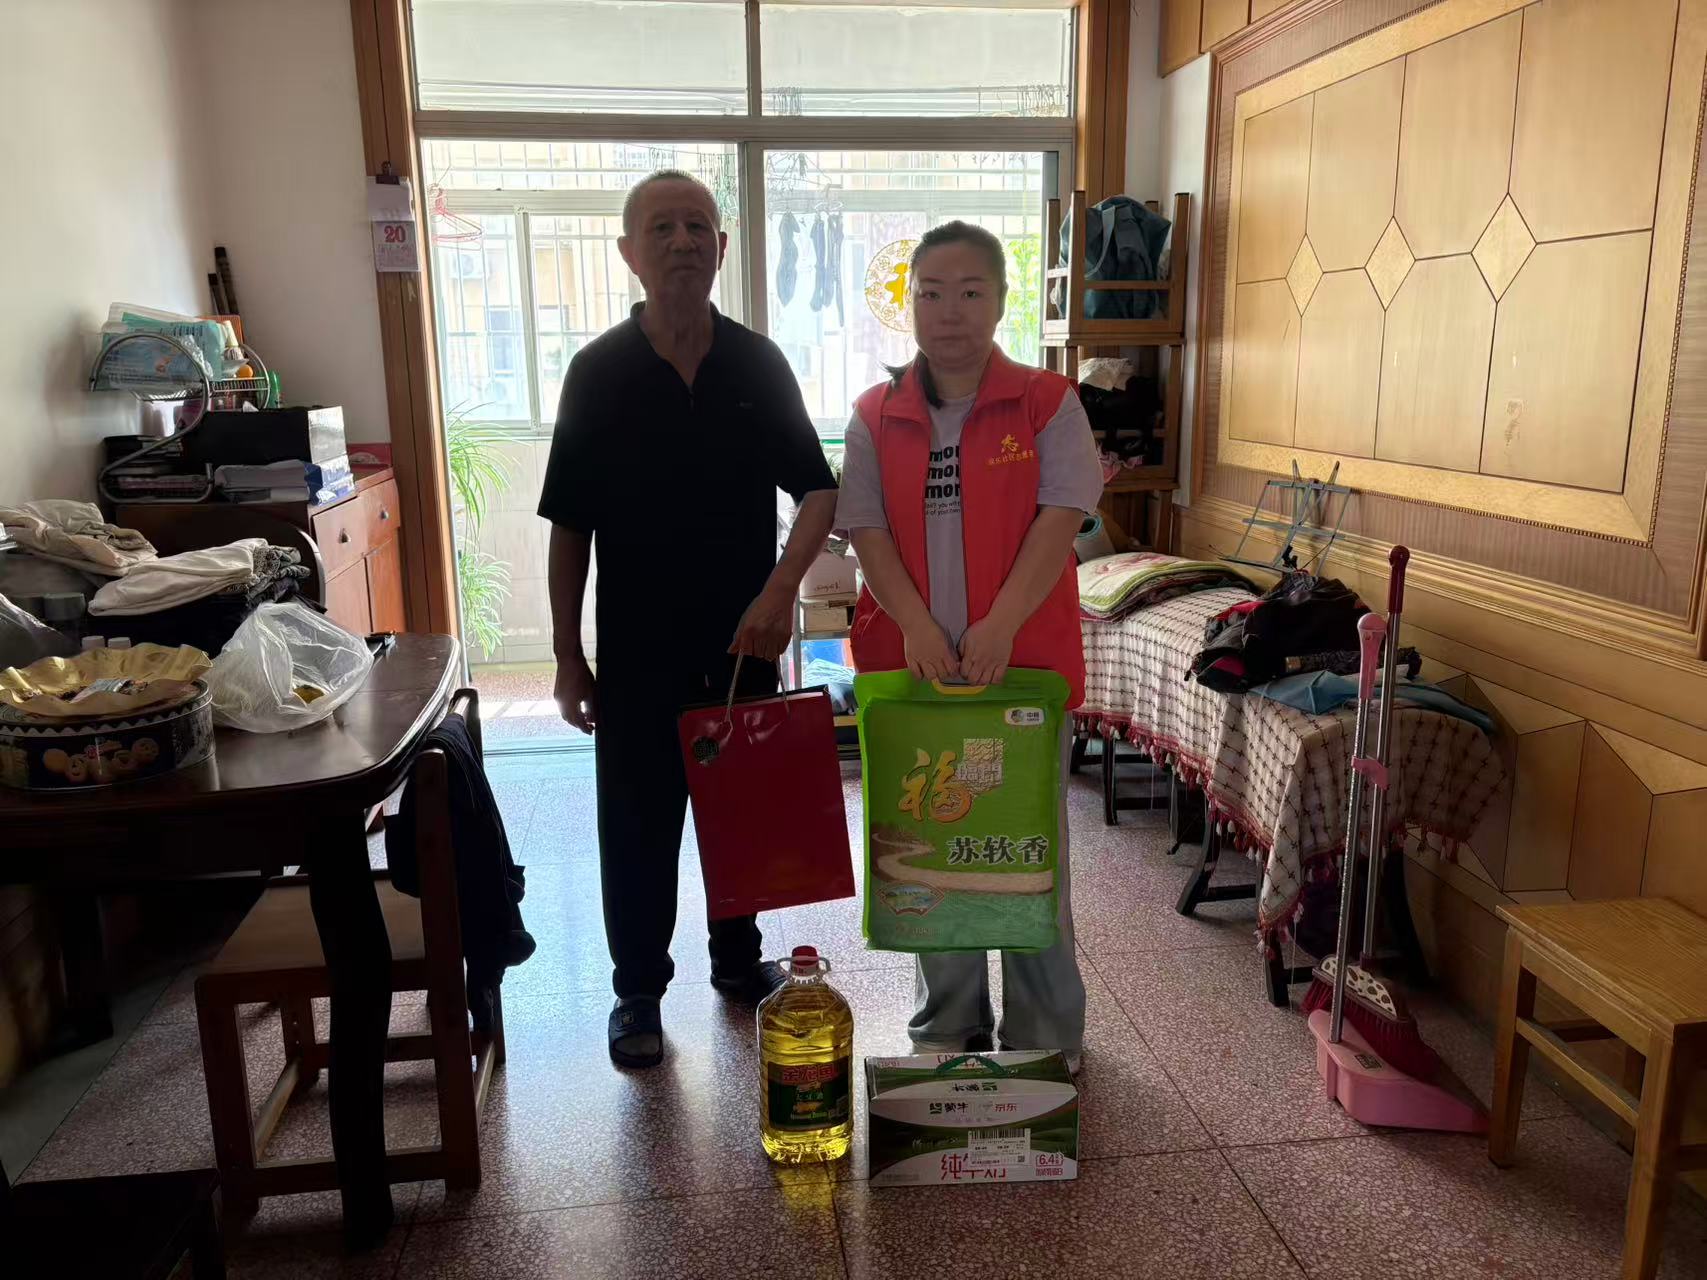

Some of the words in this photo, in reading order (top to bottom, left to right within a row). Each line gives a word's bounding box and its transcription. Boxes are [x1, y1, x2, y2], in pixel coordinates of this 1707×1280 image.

[384, 225, 406, 243] 20
[947, 833, 1049, 865] 苏软香
[1039, 1154, 1055, 1166] 6.4
